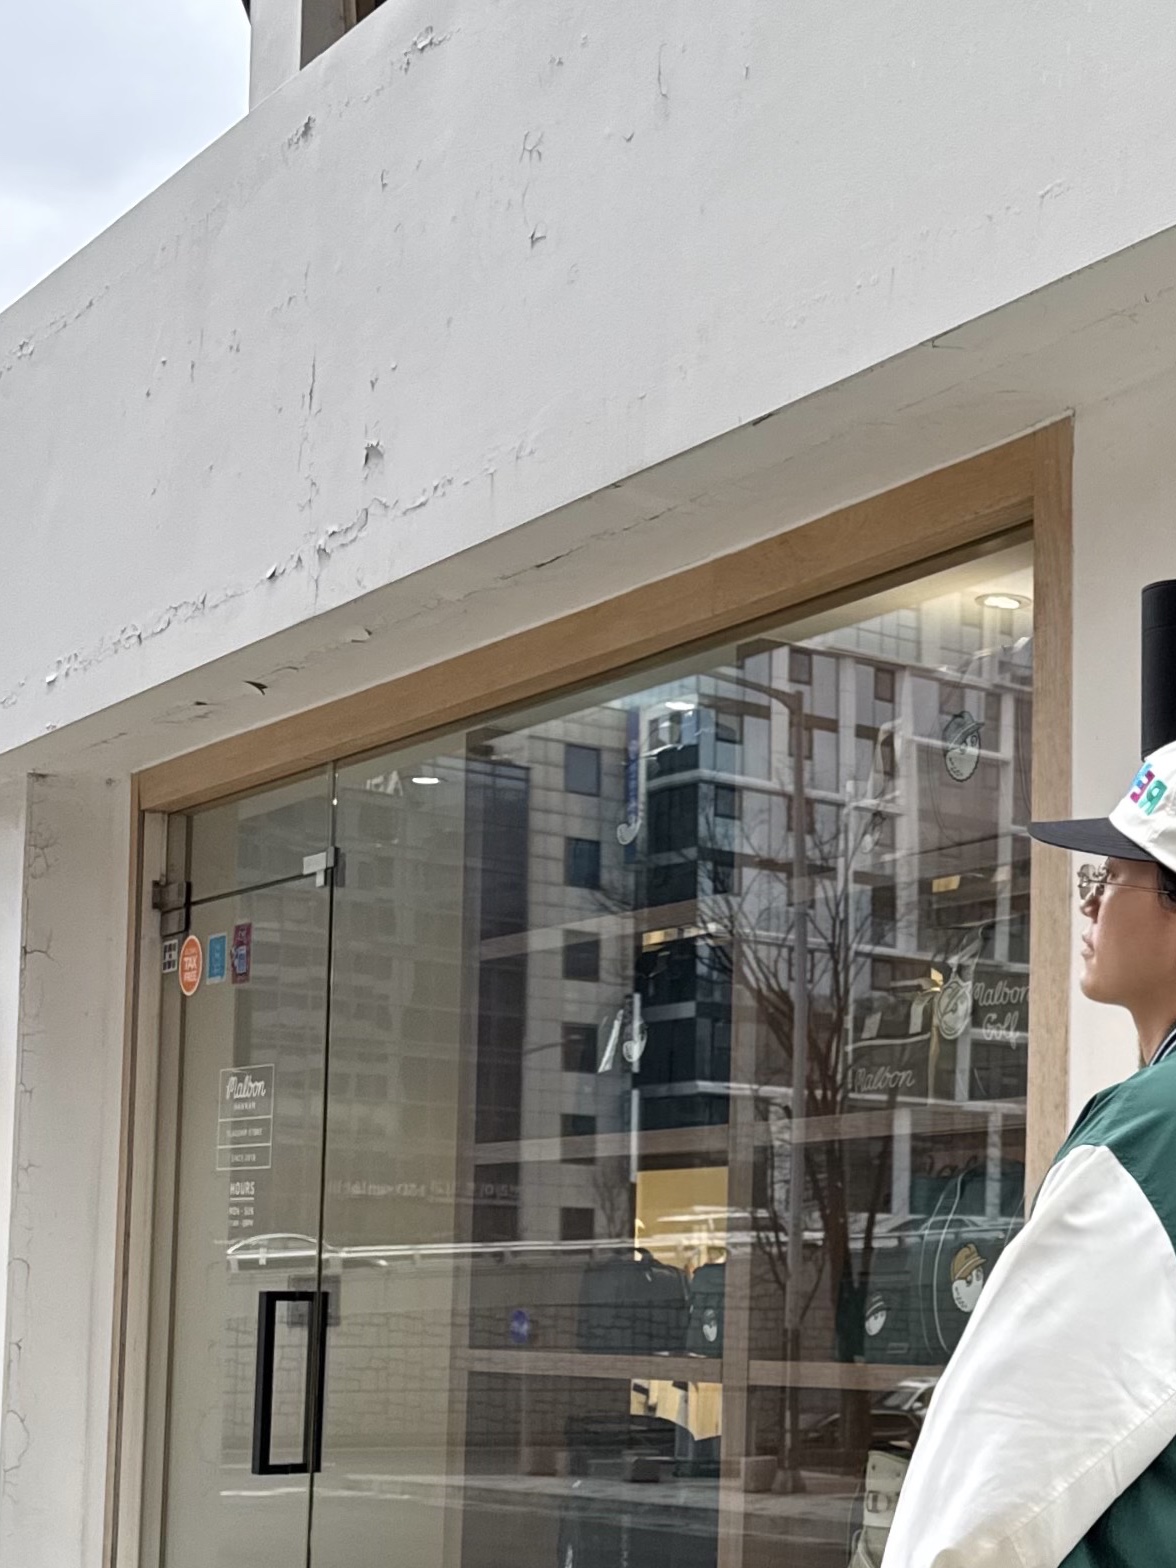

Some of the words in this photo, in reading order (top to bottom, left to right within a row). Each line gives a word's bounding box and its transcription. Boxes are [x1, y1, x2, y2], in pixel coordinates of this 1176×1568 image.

[982, 1010, 1021, 1051] Golf
[226, 1074, 267, 1100] Malbon
[229, 1181, 255, 1196] HOURS
